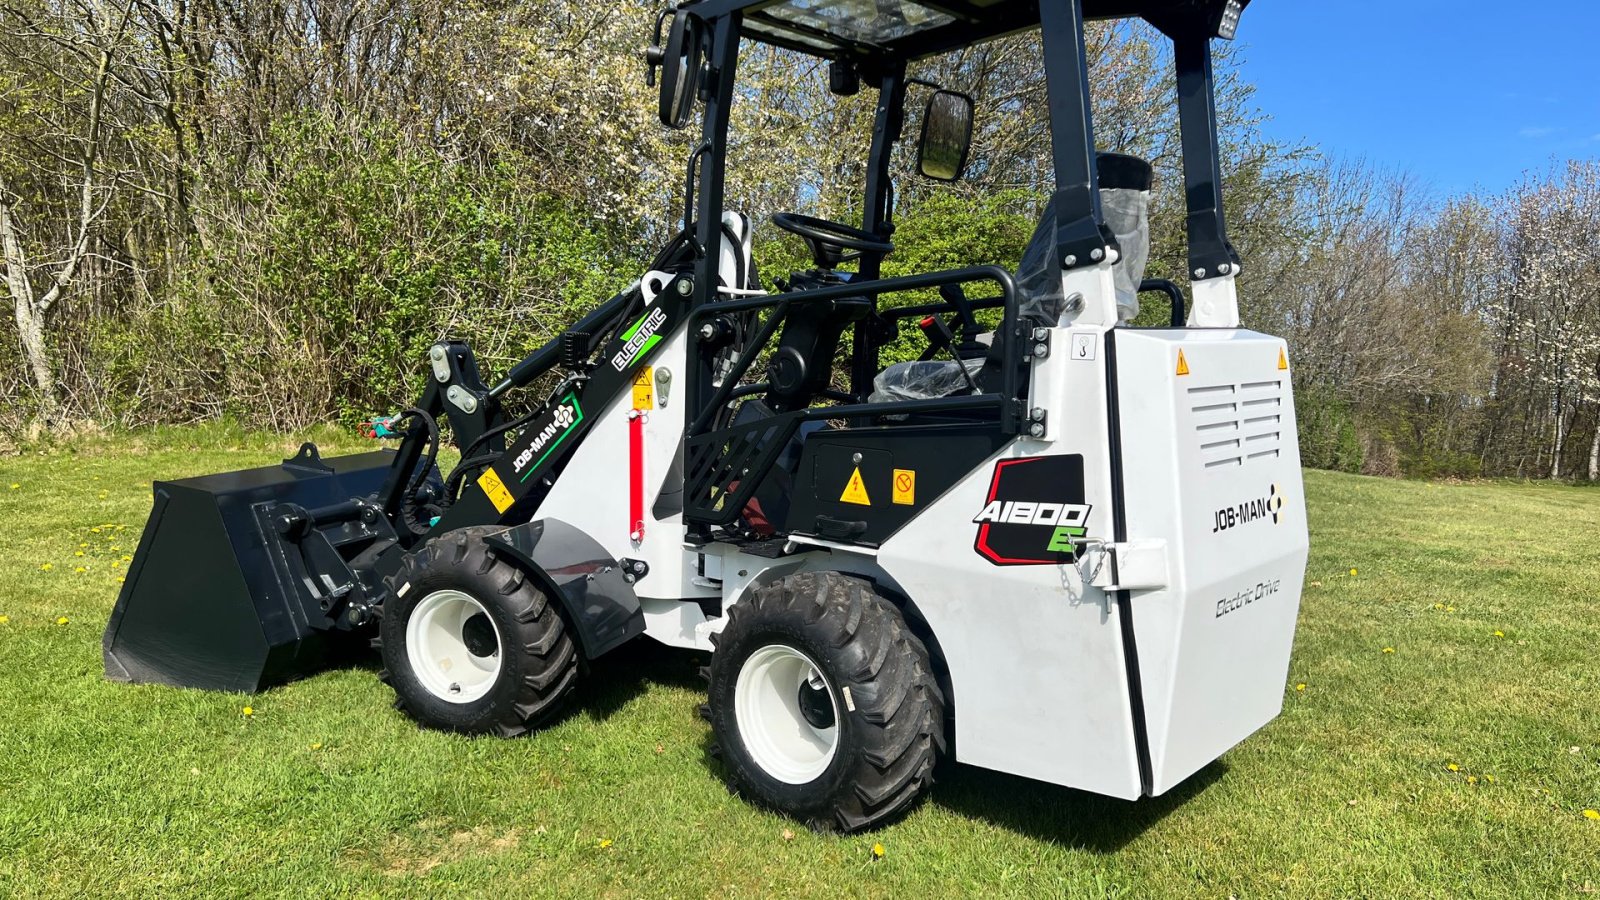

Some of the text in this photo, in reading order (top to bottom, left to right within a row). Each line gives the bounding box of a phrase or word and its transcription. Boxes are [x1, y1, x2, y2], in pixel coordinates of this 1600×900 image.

[611, 307, 667, 372] ELECTRIC
[513, 423, 558, 473] JOB-MAN
[1213, 497, 1266, 533] JOB-MAN
[1047, 526, 1087, 553] E
[1215, 579, 1280, 619] Electric Drive
